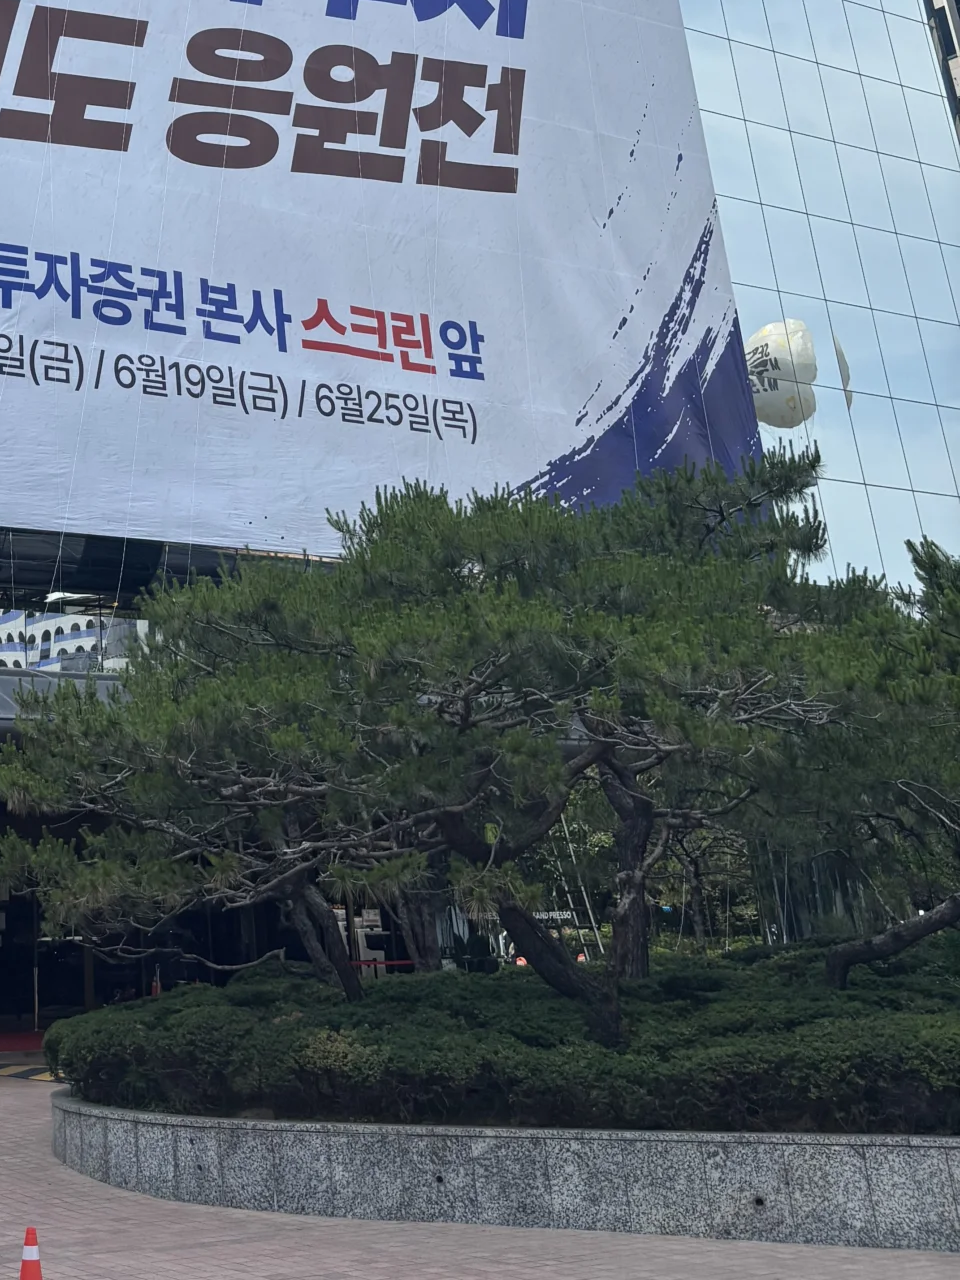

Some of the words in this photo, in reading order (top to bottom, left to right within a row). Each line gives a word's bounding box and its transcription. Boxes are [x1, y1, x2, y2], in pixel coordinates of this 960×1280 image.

[165, 27, 526, 193] 응원전
[195, 276, 292, 353] 본사
[113, 352, 290, 420] 6월19일(금)
[314, 381, 479, 445] 6월25일(목)
[549, 911, 571, 919] PRESSO
